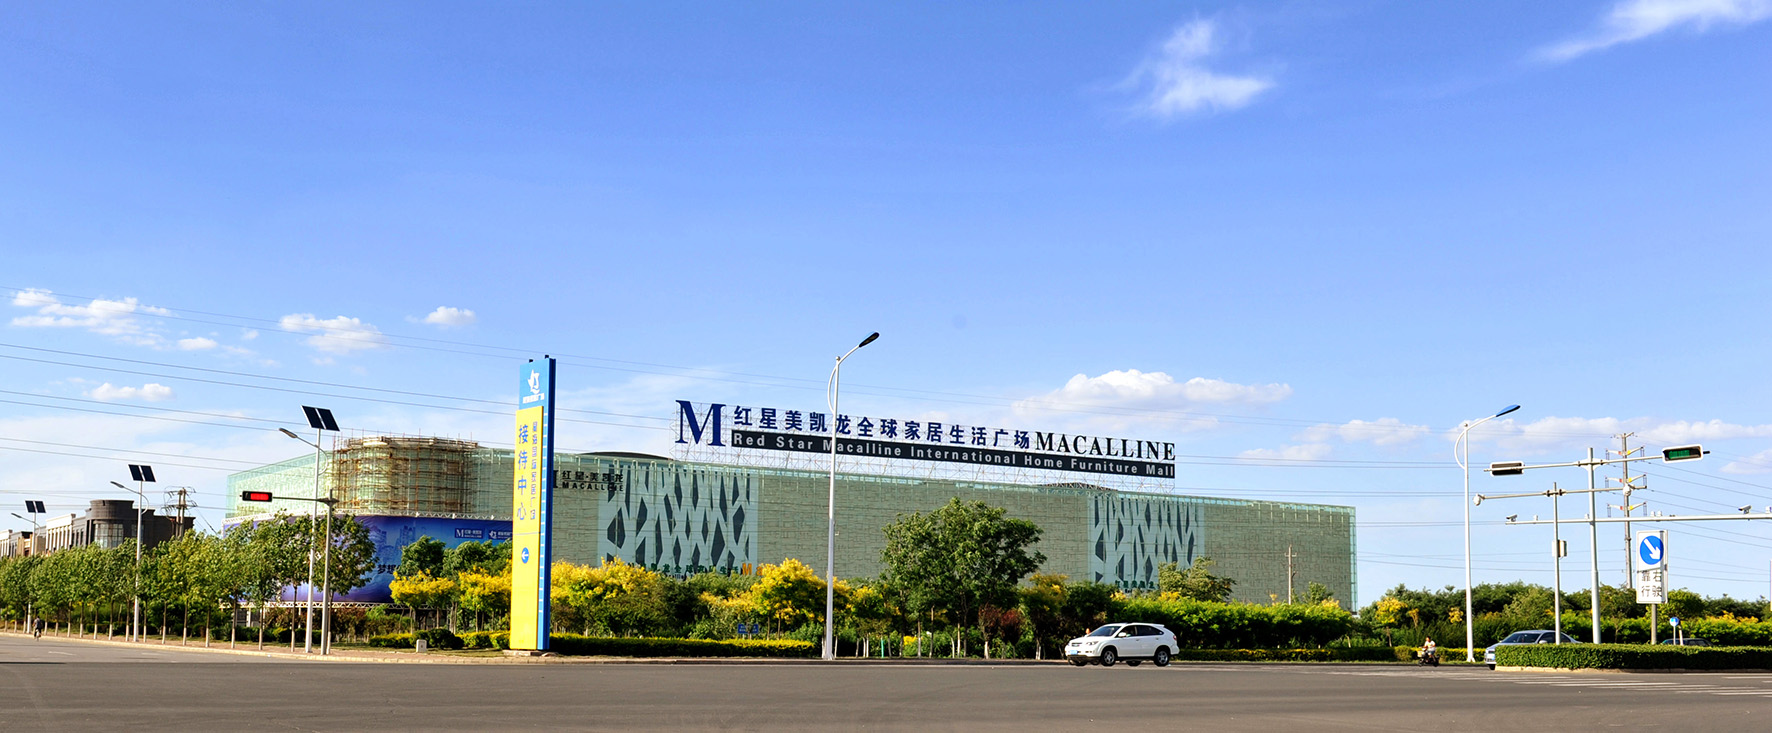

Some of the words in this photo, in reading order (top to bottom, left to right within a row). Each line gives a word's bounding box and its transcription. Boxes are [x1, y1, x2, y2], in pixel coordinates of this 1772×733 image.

[675, 400, 726, 446] M
[734, 406, 1030, 449] 红星美凯龙全球家居生活广场
[733, 432, 765, 446] Red
[776, 436, 813, 449] Star
[823, 440, 902, 455] Macalline
[911, 447, 1016, 464] International
[1024, 456, 1063, 468] Home
[1071, 458, 1138, 473] Furniture
[1146, 464, 1174, 476] Mall
[1035, 431, 1176, 460] MACALLINE
[517, 424, 529, 520] 接待中心
